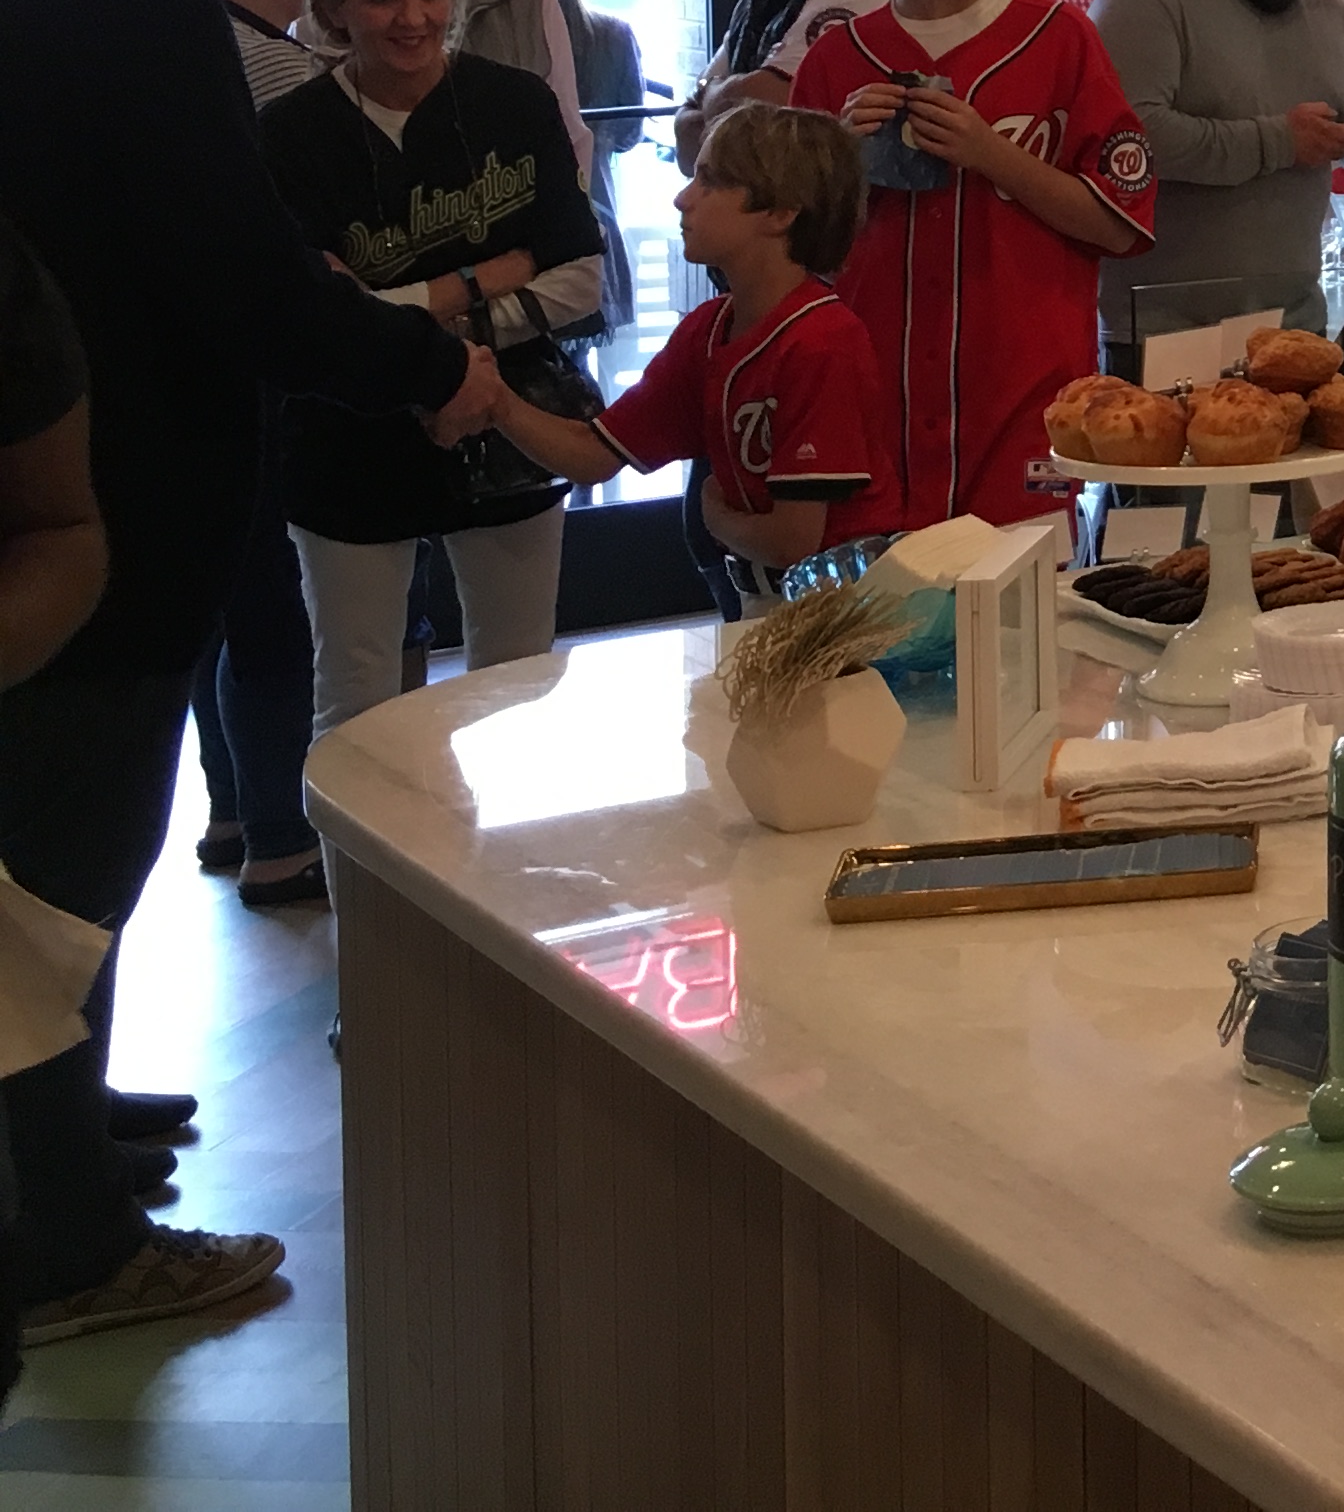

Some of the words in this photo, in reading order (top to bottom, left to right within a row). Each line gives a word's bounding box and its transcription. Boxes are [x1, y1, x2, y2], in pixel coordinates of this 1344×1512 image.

[1101, 130, 1154, 158] WASHINGTON
[1113, 146, 1143, 177] W
[1103, 172, 1153, 192] NATIONALS
